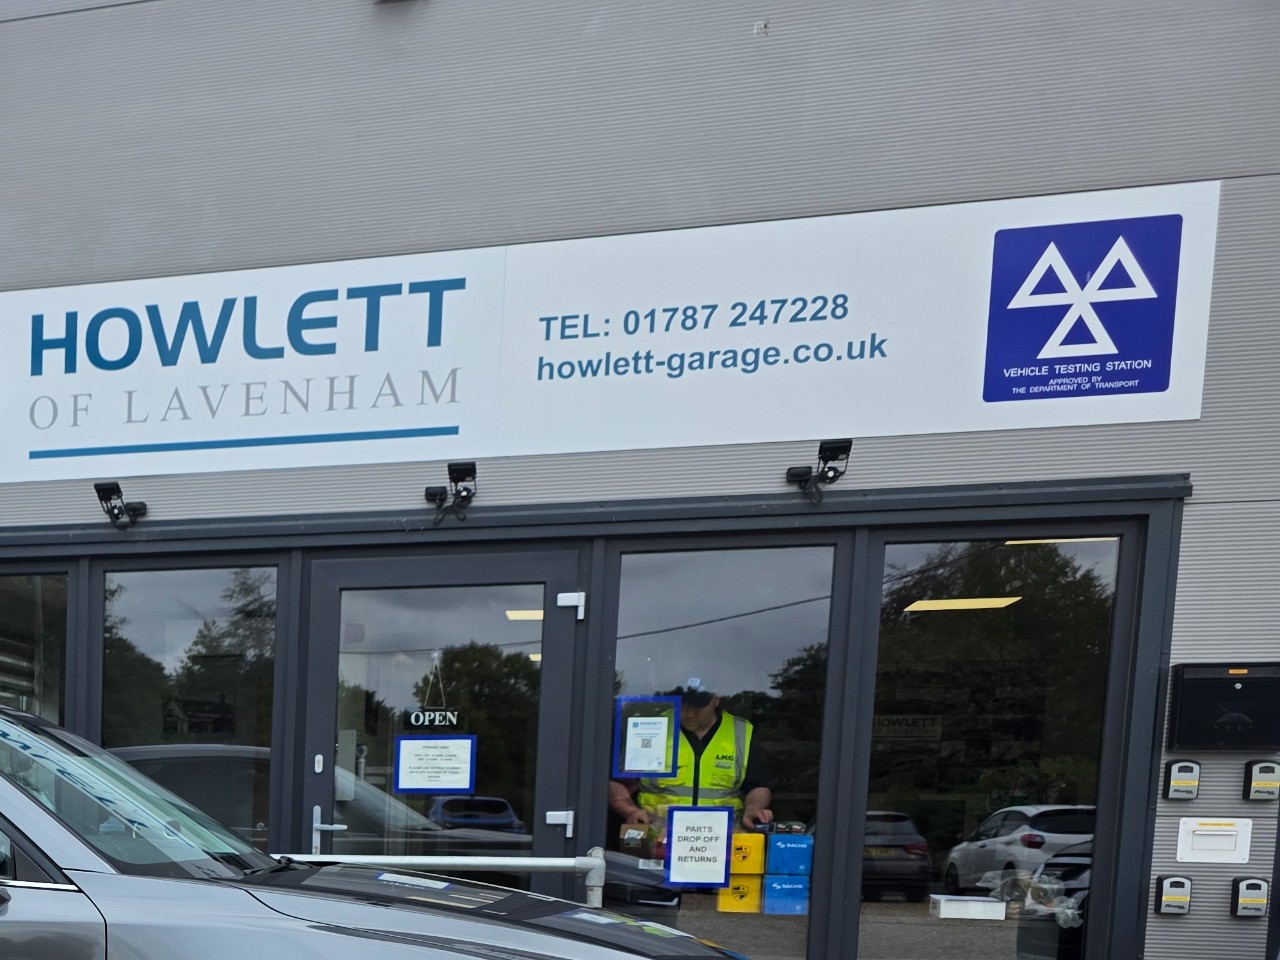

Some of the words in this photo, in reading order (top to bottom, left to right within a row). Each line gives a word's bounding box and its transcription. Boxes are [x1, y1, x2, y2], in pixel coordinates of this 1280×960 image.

[31, 277, 466, 376] HOWLETT
[539, 312, 612, 342] TEL:
[623, 303, 718, 337] 01787
[729, 293, 850, 328] 247228
[537, 331, 888, 381] howlett-garage.co.uk
[1003, 365, 1049, 378] VEHICLE
[1054, 362, 1101, 375] TESTING
[1106, 359, 1152, 371] STATION
[29, 391, 92, 430] OF
[123, 366, 461, 424] LAVENHAM
[1029, 384, 1077, 393] DEPARTMENT
[1095, 380, 1139, 389] TRANSPORT
[1048, 377, 1088, 385] APPROVED
[410, 711, 458, 726] OPEN
